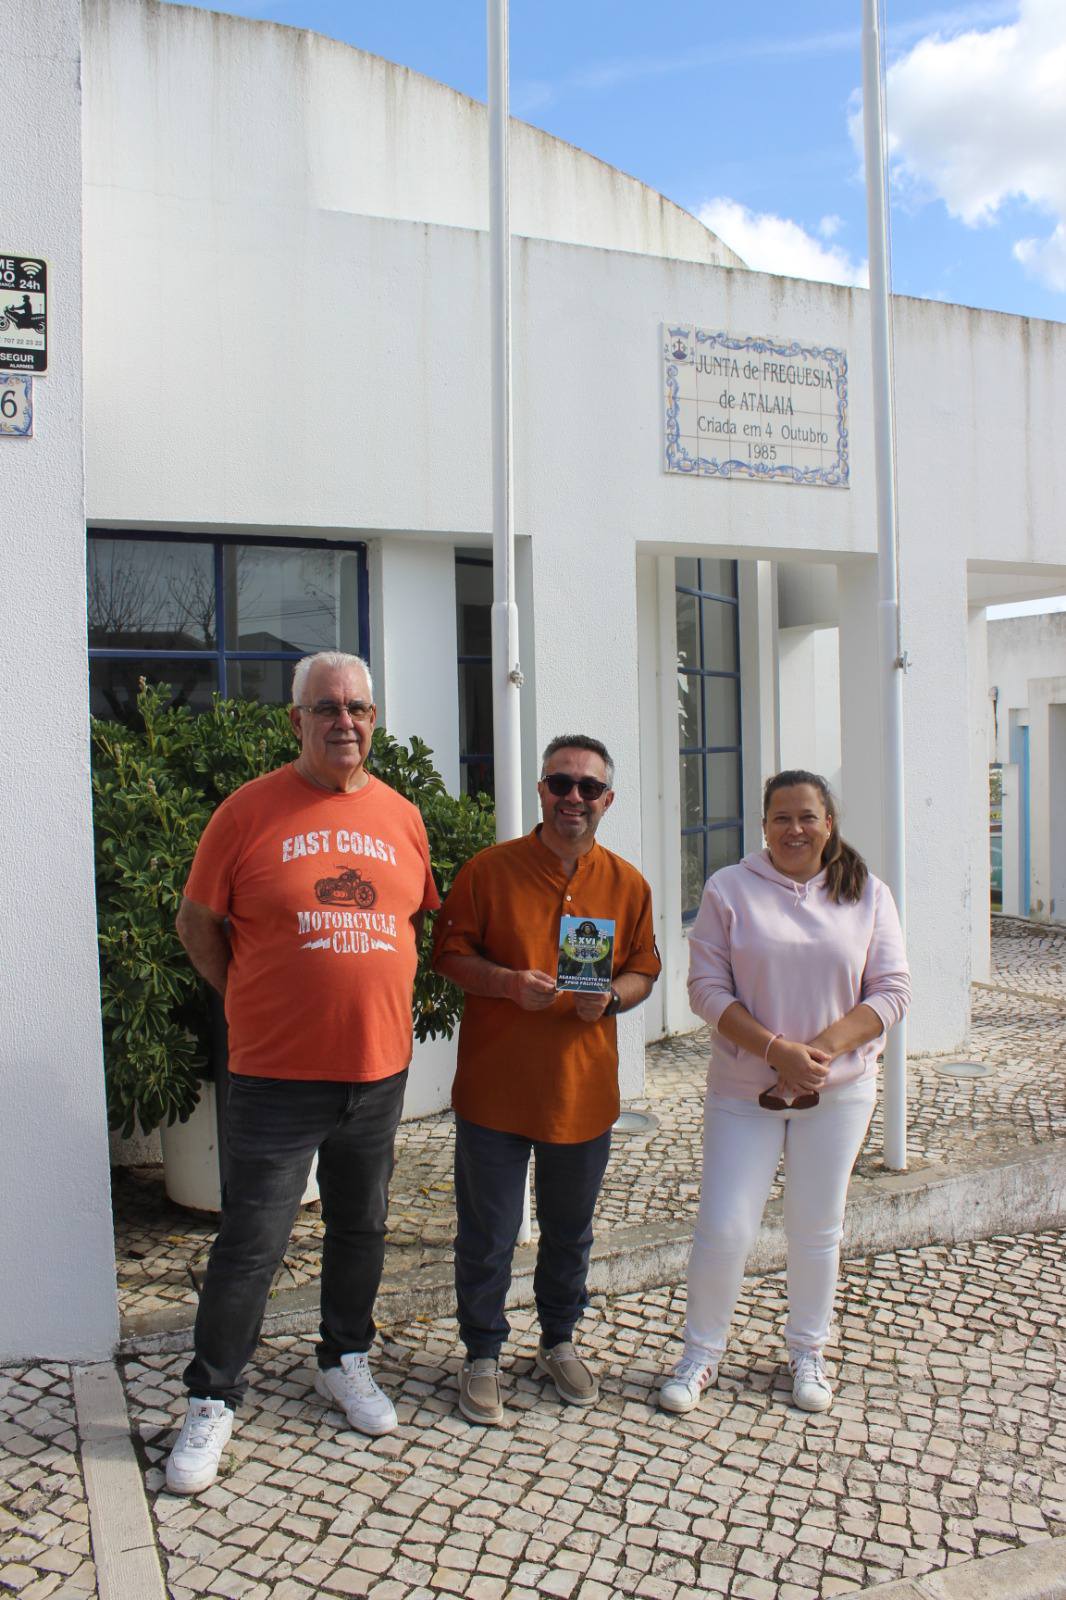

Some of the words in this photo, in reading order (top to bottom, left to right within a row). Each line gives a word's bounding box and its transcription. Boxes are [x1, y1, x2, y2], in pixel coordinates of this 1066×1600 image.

[0, 270, 15, 283] O
[19, 279, 40, 290] 24h
[696, 354, 739, 378] JUNTA
[743, 361, 759, 380] de
[763, 362, 833, 389] FREGUESIA
[0, 390, 17, 418] 6
[719, 390, 735, 409] de
[740, 392, 794, 415] ATALAIA
[697, 415, 736, 434] Criada
[743, 423, 762, 437] em
[764, 422, 773, 438] 4
[781, 424, 828, 443] Outubro
[747, 443, 777, 460] 1985
[282, 830, 332, 863] EAST
[336, 829, 397, 866] COAST
[297, 911, 397, 937] MOTORCYCLE
[332, 930, 370, 954] CLUB
